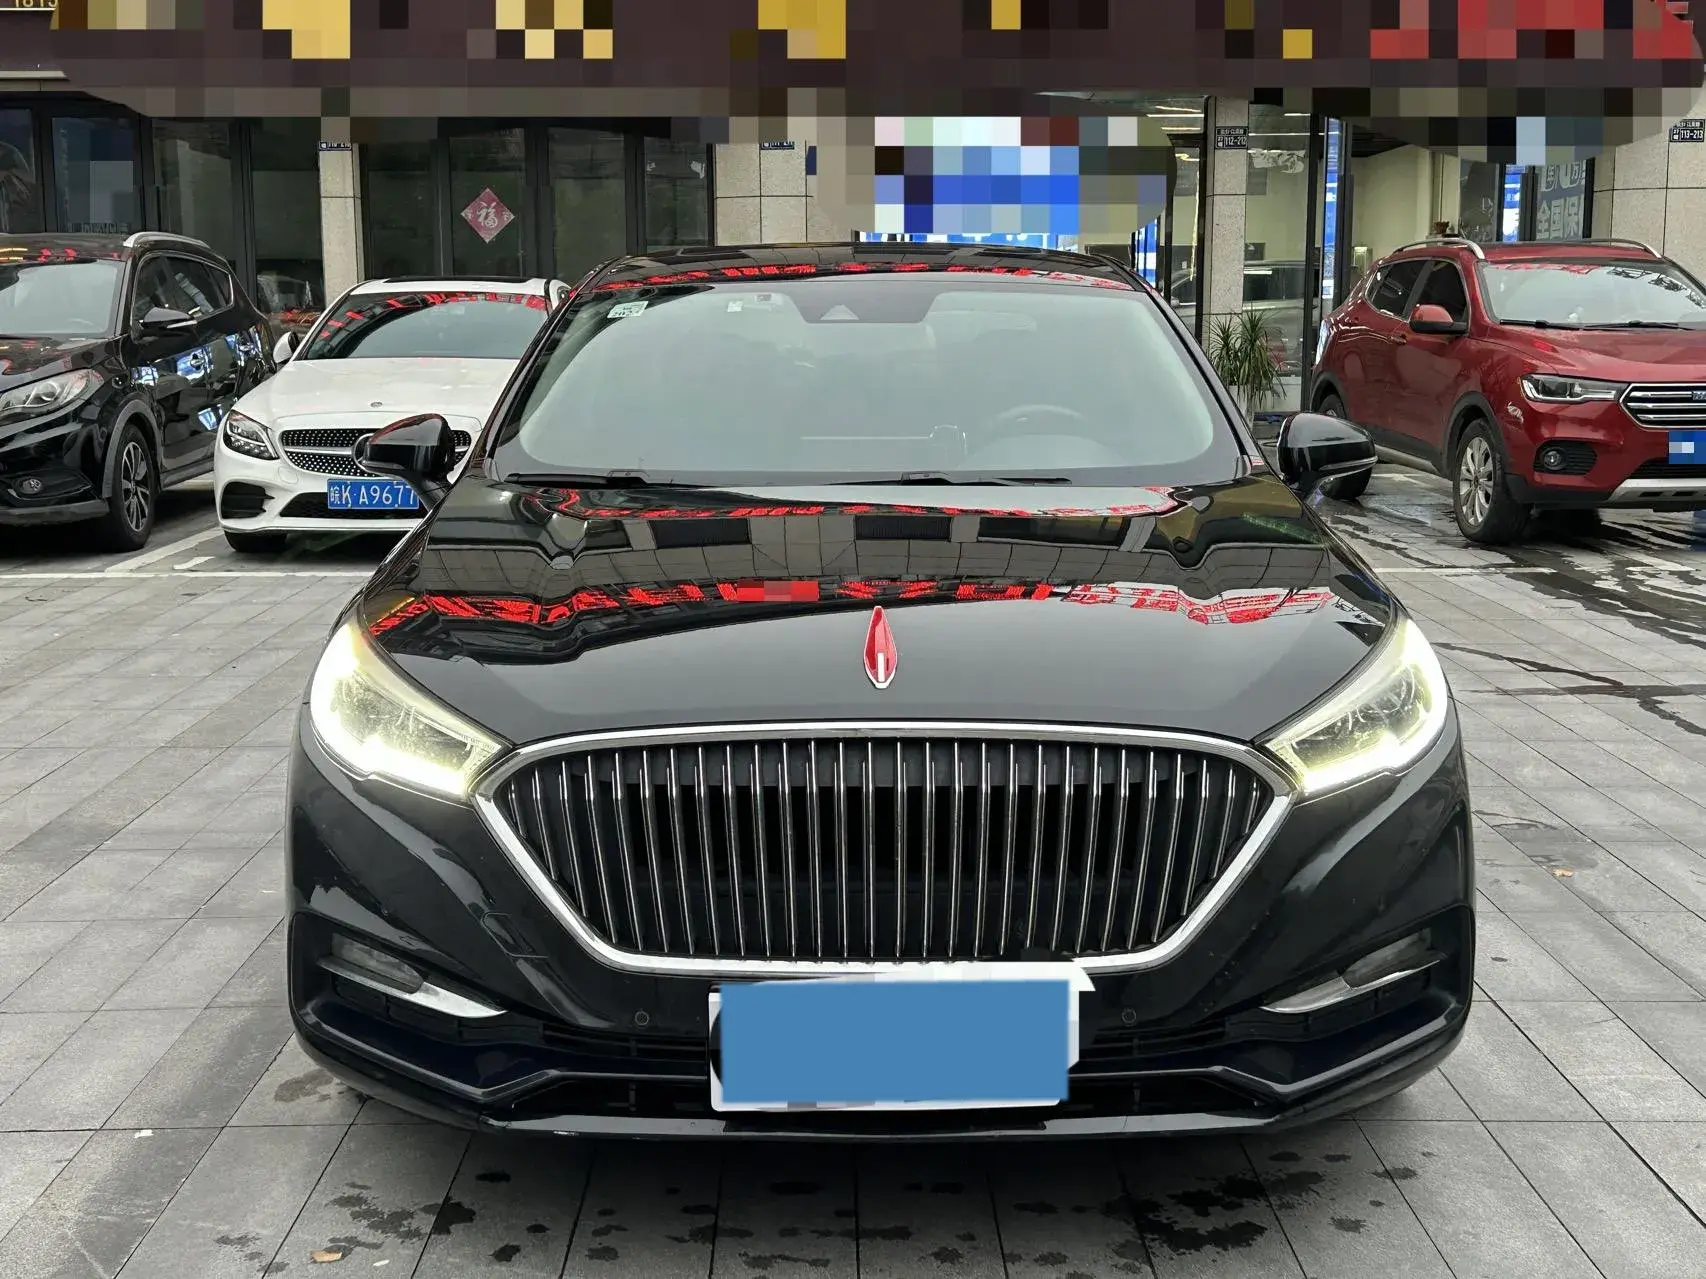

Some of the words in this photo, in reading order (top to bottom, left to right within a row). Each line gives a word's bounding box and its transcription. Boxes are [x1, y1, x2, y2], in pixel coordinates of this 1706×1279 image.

[477, 201, 498, 228] 福
[1536, 194, 1585, 241] 全国保
